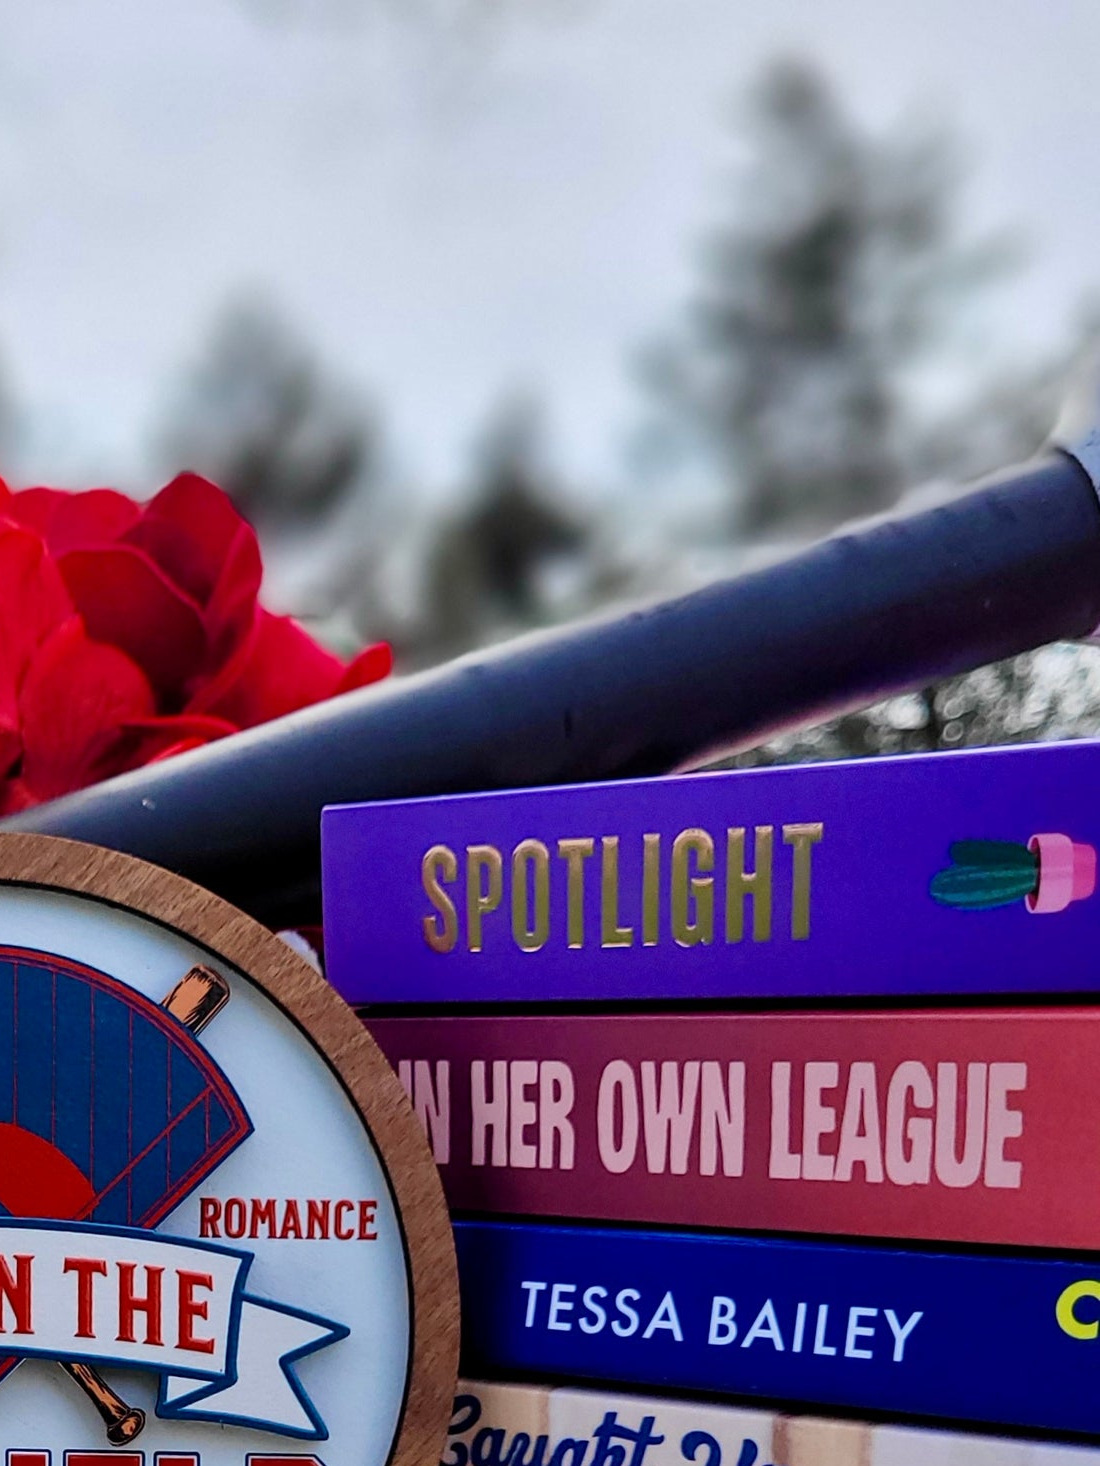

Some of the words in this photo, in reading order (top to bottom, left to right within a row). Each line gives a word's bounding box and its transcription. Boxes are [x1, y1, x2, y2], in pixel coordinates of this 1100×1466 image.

[421, 822, 824, 954] SPOTLIGHT
[398, 1060, 451, 1166] IN
[470, 1059, 575, 1170] HER
[597, 1059, 745, 1177] OWN
[768, 1060, 1028, 1189] LEAGUE
[199, 1197, 378, 1241] ROMANCE
[62, 1256, 216, 1355] THE
[520, 1280, 685, 1344] TESSA
[706, 1295, 924, 1363] BAILEY
